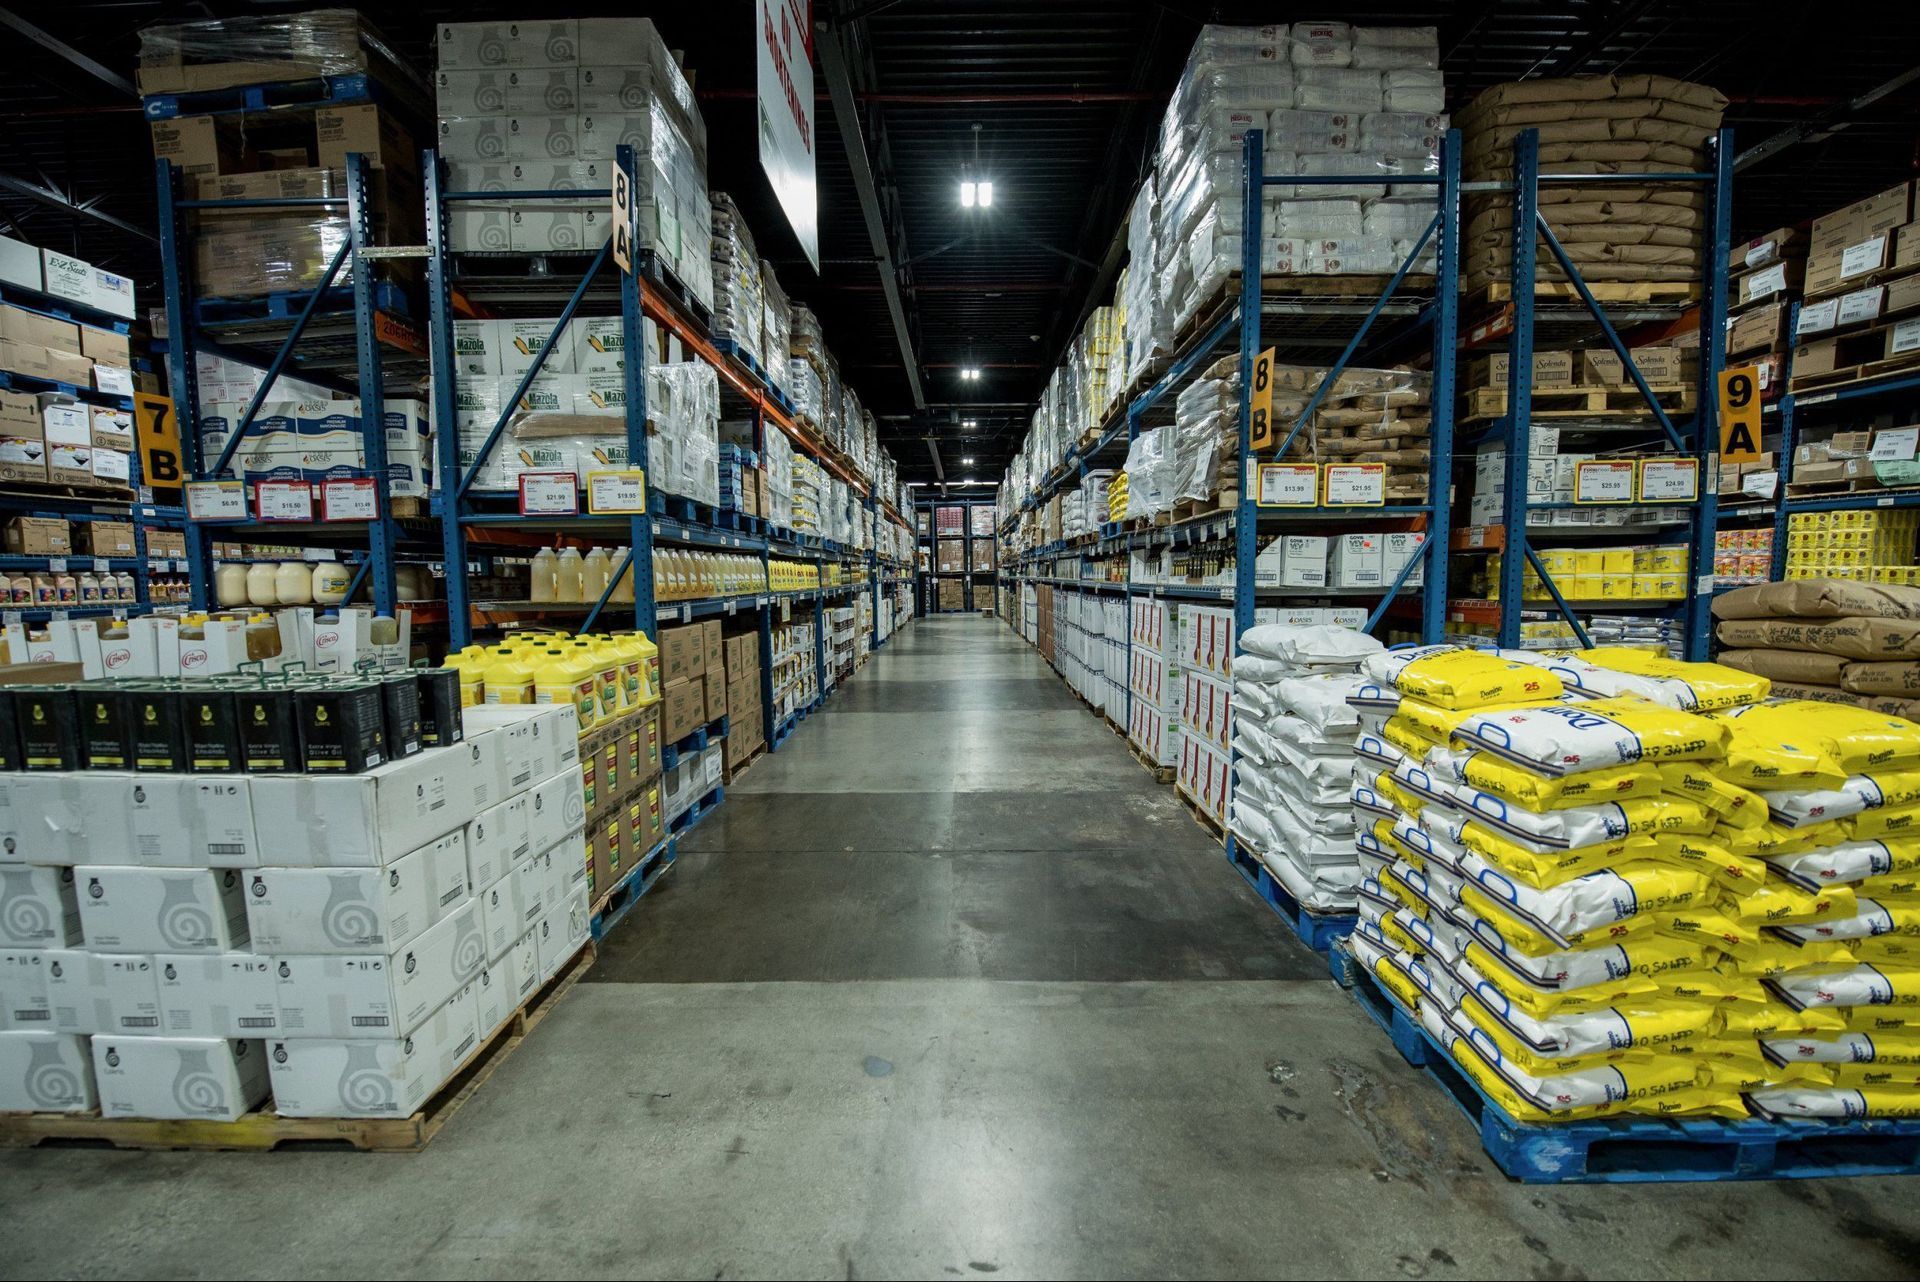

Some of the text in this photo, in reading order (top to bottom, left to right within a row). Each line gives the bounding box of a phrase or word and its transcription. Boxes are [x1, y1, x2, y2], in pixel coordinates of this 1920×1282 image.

[616, 173, 626, 209] 8
[617, 224, 630, 262] A
[457, 338, 484, 350] Mazola
[1536, 359, 1566, 369] Splenda
[1592, 356, 1618, 367] Splenda
[1635, 355, 1665, 365] Splenda
[1254, 358, 1268, 392] 8
[1727, 374, 1752, 407] 9
[528, 393, 558, 405] Mazola
[143, 402, 169, 434] 7
[1252, 408, 1267, 442] B
[1725, 422, 1757, 456] A
[533, 450, 562, 462] Mazola
[149, 450, 179, 481] B
[317, 633, 338, 648] Crisco
[106, 650, 130, 668] Crisco
[183, 651, 206, 668] Crisco
[1480, 685, 1503, 698] Domino
[1524, 682, 1540, 692] 25
[1563, 754, 1580, 763] 25
[1868, 749, 1895, 761] Domino
[1617, 780, 1634, 791] 25
[1683, 774, 1712, 788] Domino
[1886, 815, 1913, 825] Domino
[1681, 845, 1707, 857] Domino
[1672, 919, 1701, 929] Domino
[1610, 925, 1628, 936] 25
